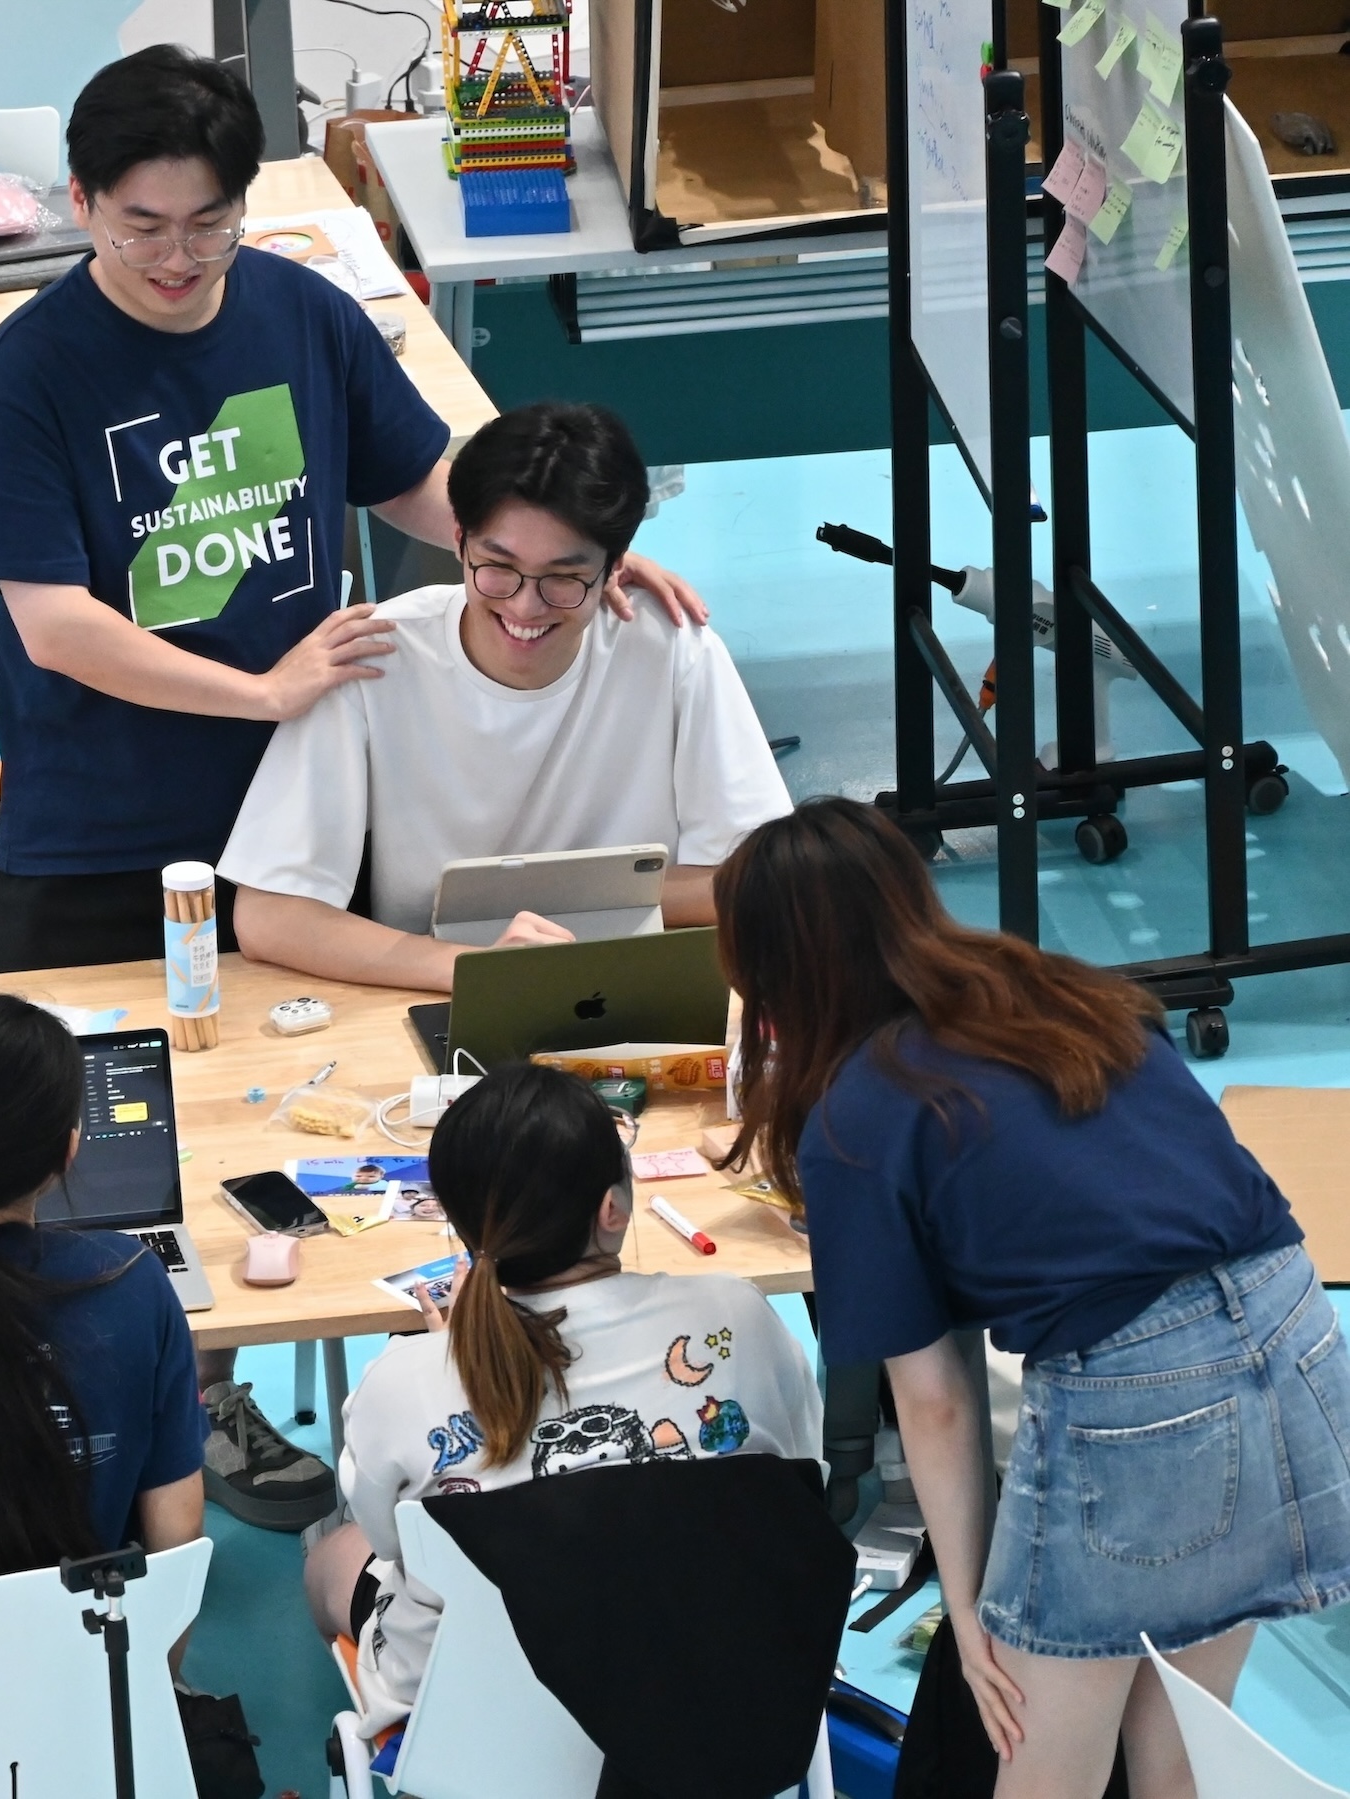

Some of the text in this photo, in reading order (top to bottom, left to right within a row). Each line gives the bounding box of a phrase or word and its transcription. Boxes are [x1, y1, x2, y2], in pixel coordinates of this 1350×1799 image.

[158, 426, 242, 486] GET
[130, 474, 308, 539] SUSTAINABILITY
[156, 515, 295, 588] DONE
